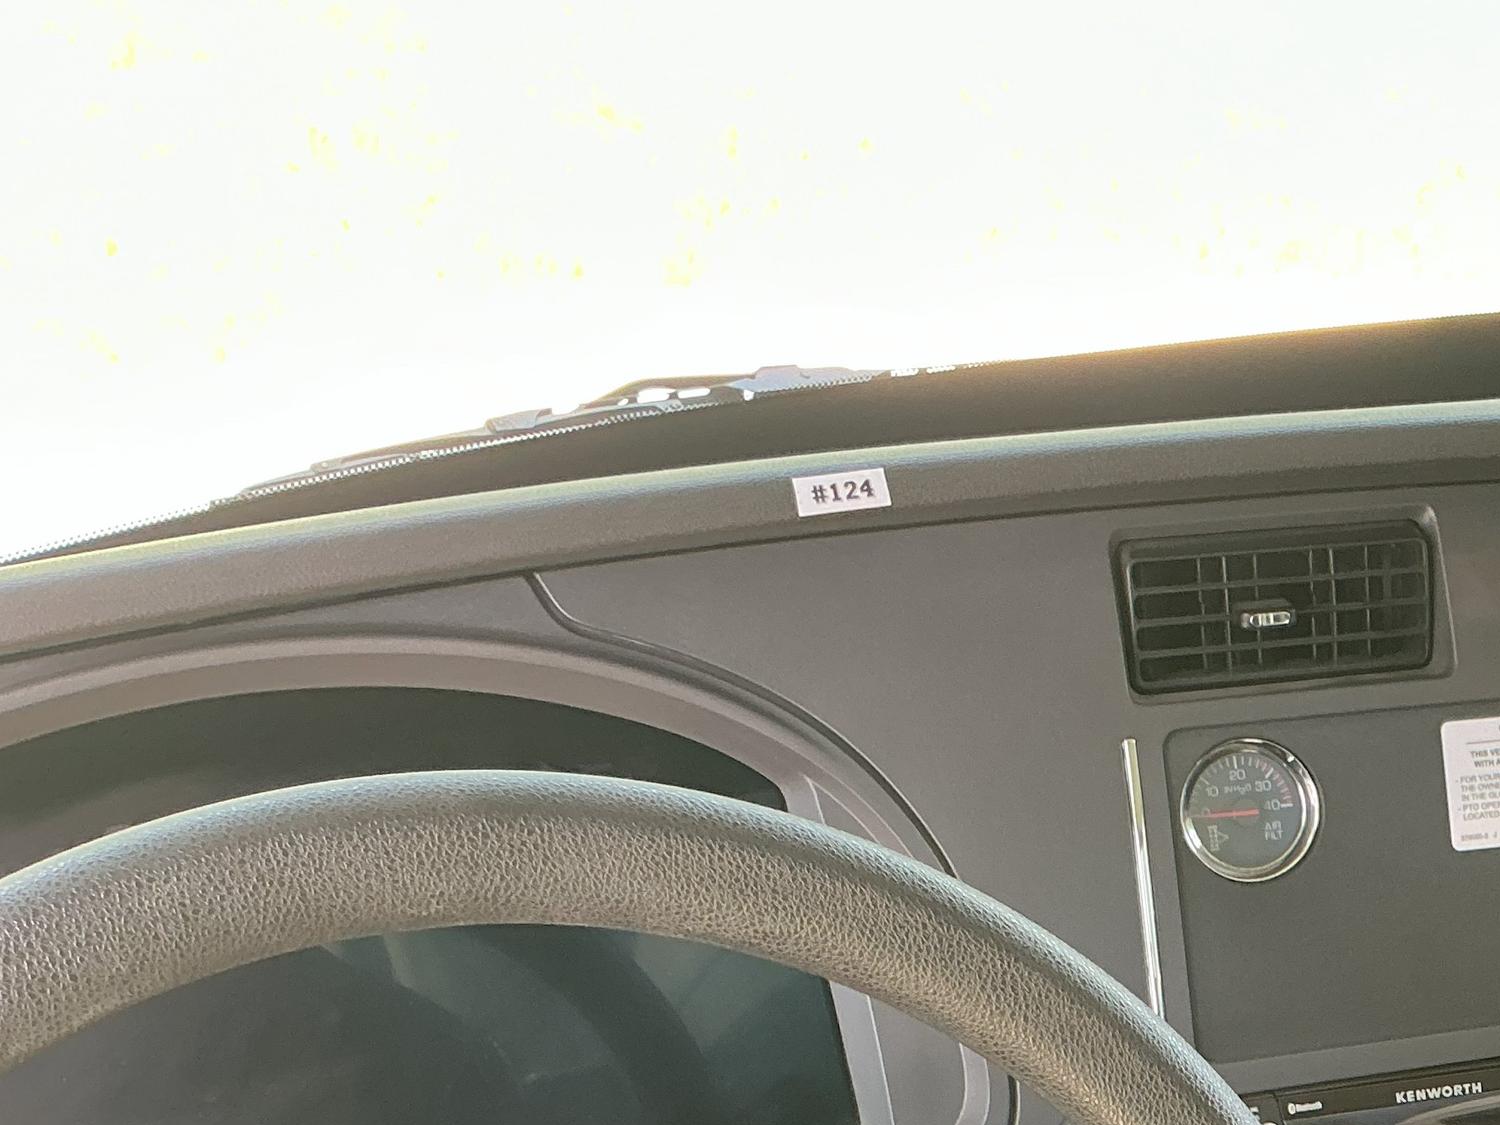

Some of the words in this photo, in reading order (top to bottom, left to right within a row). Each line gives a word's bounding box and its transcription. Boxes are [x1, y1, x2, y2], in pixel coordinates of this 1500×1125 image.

[811, 479, 875, 504] #124
[1471, 750, 1488, 758] THIS
[1474, 760, 1494, 768] WITH
[1229, 769, 1246, 781] 20
[1460, 775, 1477, 784] FOR
[1479, 774, 1500, 782] YOUR
[1206, 786, 1218, 797] 10
[1255, 780, 1271, 793] 30
[1461, 784, 1476, 792] THE
[1471, 792, 1487, 800] THE
[1264, 799, 1281, 811] 40
[1463, 803, 1479, 812] PTO
[1463, 810, 1500, 821] LOCATED
[1265, 820, 1281, 830] AIR
[1395, 1082, 1482, 1104] KENWORTH
